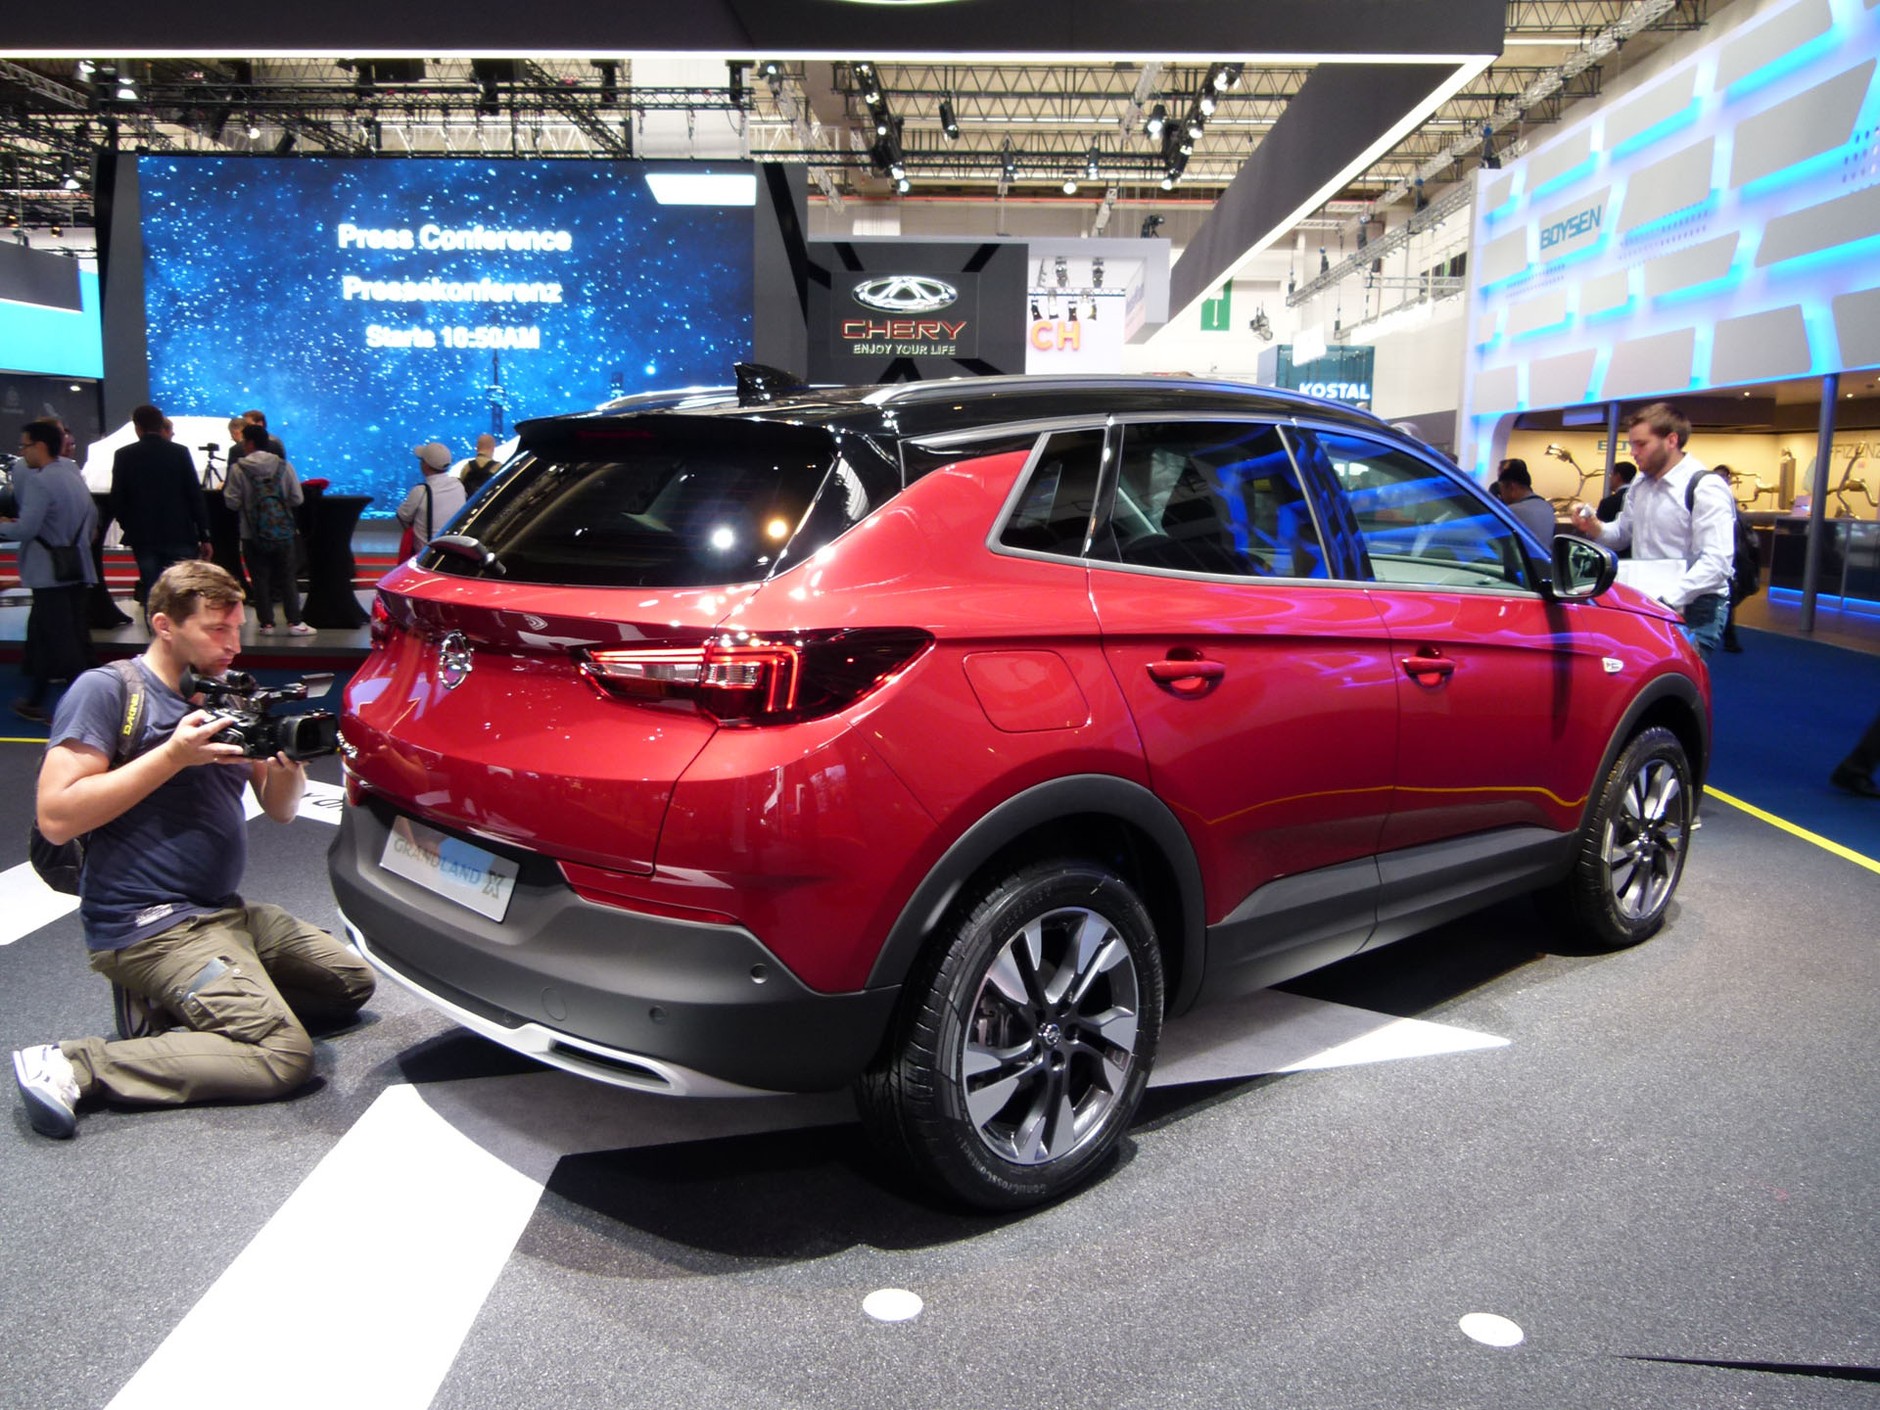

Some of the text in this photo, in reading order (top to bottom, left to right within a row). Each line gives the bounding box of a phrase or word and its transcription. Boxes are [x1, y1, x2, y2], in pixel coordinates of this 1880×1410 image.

[338, 223, 573, 251] Press Conference
[1540, 204, 1602, 250] BOYSEN
[342, 275, 563, 303] Pressekonferenz
[365, 323, 437, 349] Starts
[841, 320, 967, 341] CHERY
[853, 343, 957, 356] ENJOY YOUR LIFE
[1299, 382, 1370, 400] KOSTAL
[393, 837, 506, 899] GRANDLAND X
